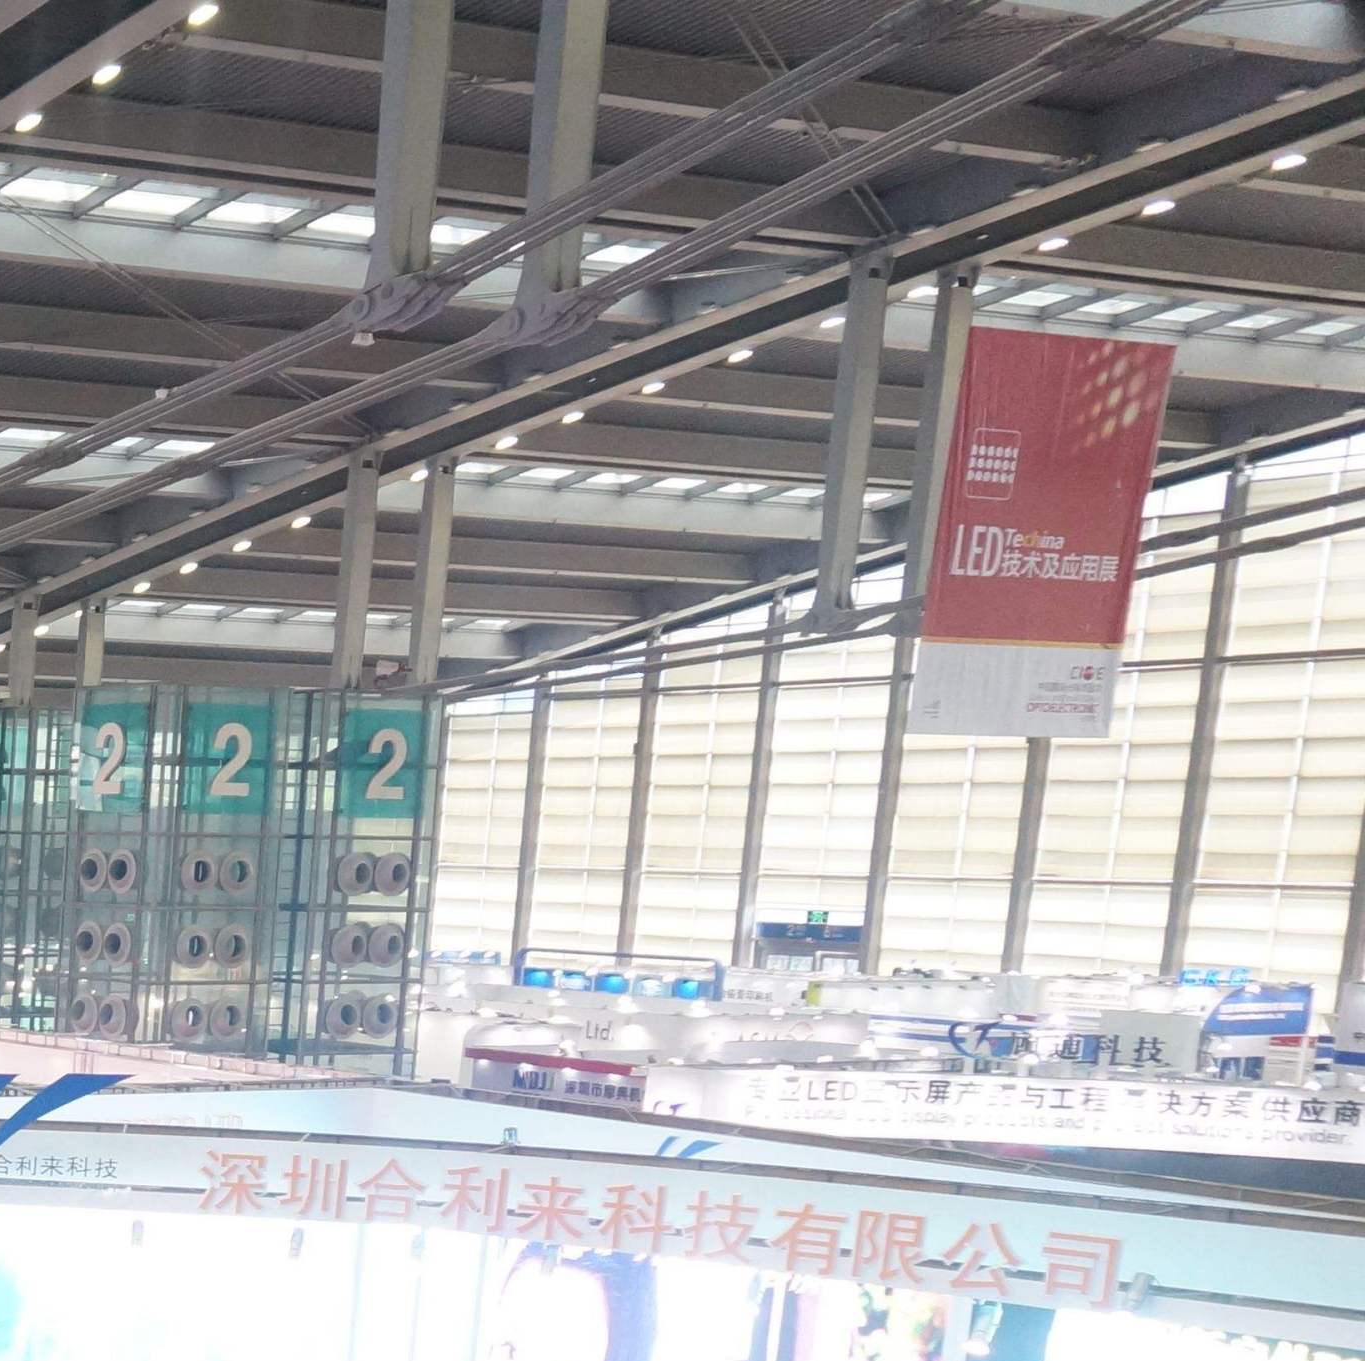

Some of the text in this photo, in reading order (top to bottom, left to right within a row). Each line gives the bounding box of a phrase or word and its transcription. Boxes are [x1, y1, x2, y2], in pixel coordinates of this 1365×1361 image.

[949, 523, 1003, 577] LED
[1000, 551, 1120, 583] 技术及应用展
[94, 722, 127, 796] 2
[209, 722, 253, 797] 2
[367, 728, 408, 800] 2
[197, 1147, 1122, 1308] 深圳合利来科技有限公司
